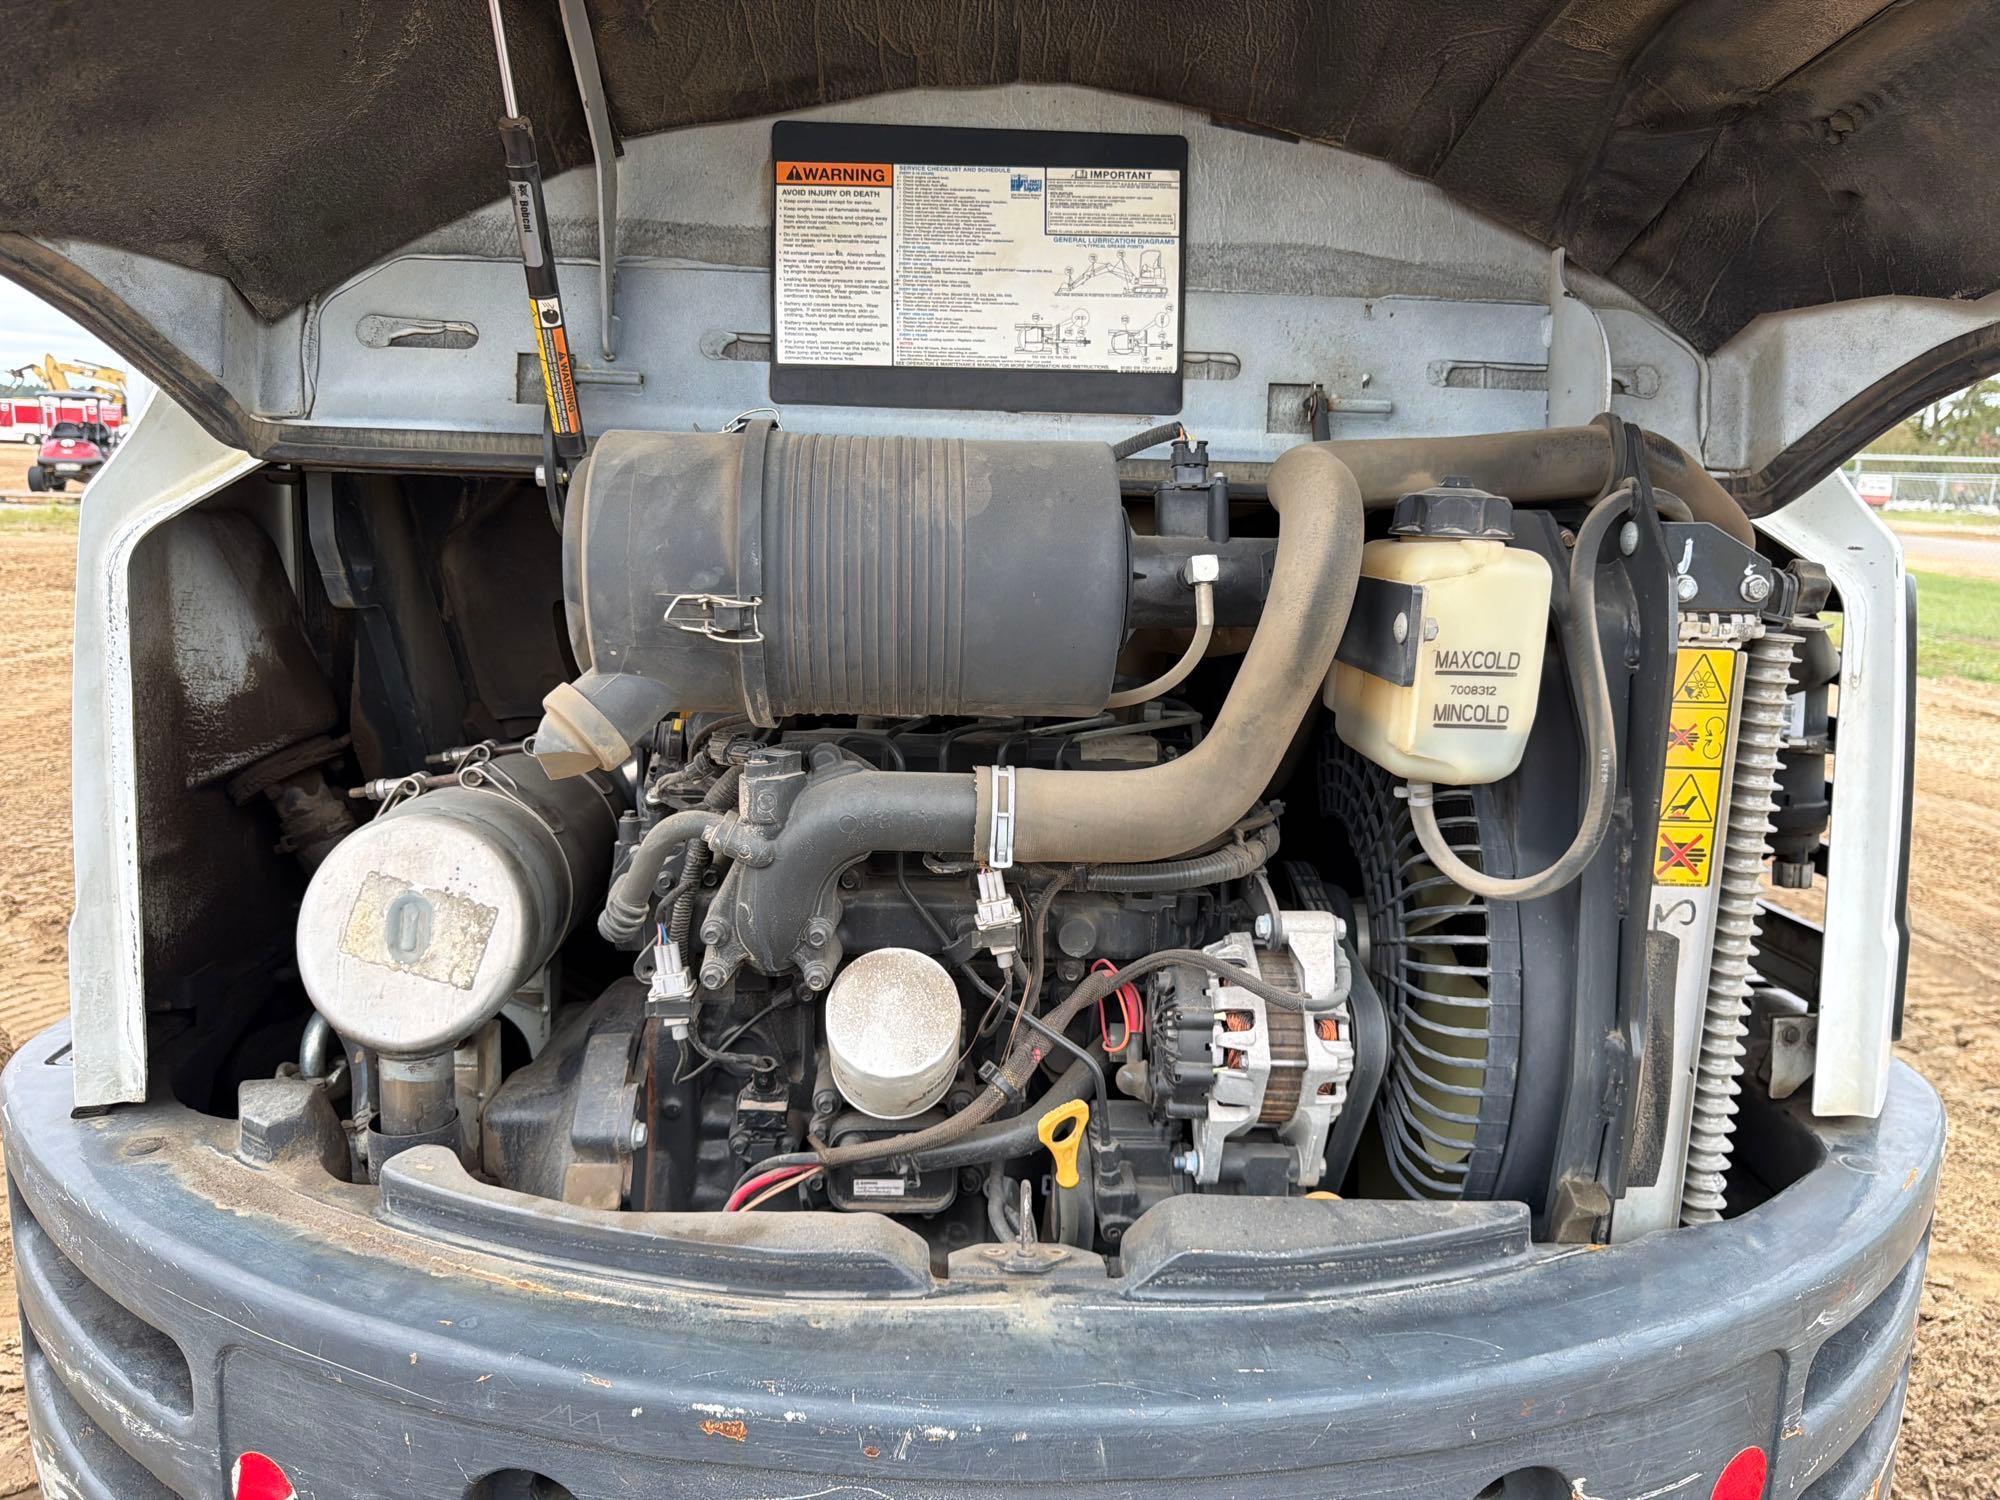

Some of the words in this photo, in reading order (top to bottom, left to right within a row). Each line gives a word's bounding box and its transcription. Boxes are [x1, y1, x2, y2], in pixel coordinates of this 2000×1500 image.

[803, 168, 885, 182] WARNING
[1090, 171, 1152, 179] IMPORTANT
[520, 200, 532, 233] Bobcat
[561, 364, 576, 412] WARNING
[1435, 650, 1520, 670] MAXCOLD
[1450, 685, 1497, 695] 7008312
[1433, 704, 1509, 723] MINCOLD
